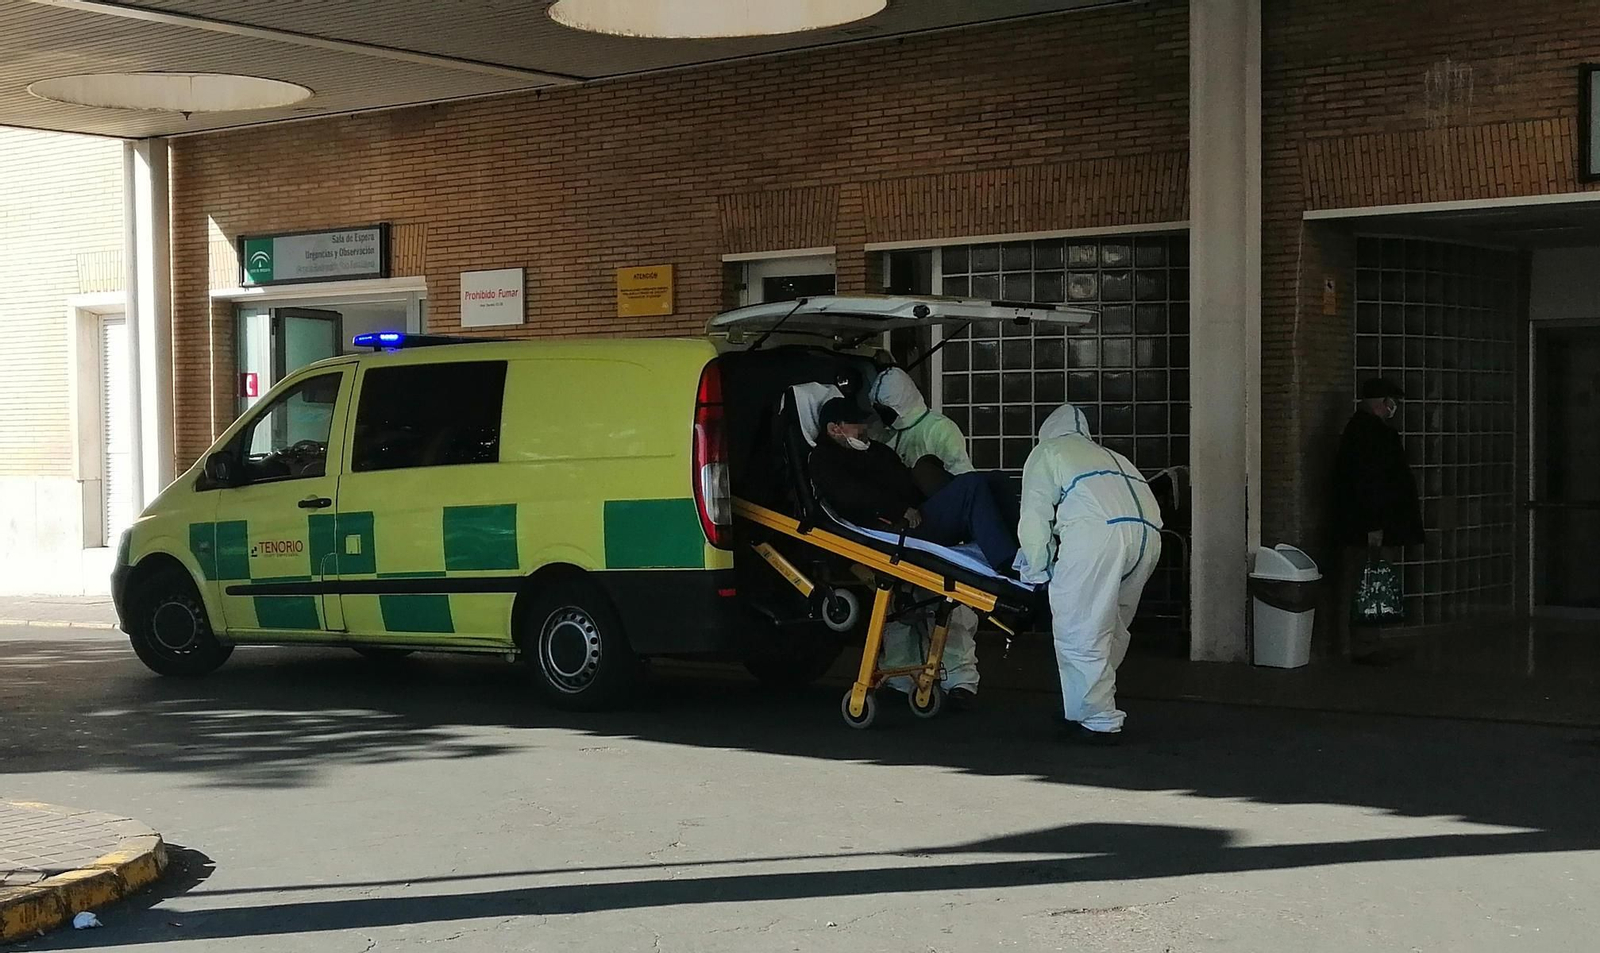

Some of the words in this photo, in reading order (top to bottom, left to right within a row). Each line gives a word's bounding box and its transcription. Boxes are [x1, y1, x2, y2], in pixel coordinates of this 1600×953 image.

[332, 234, 344, 243] Sala
[346, 234, 353, 243] de
[354, 233, 375, 244] Espera
[305, 248, 333, 261] Urgencias
[333, 251, 338, 259] y
[339, 246, 375, 257] Observación
[464, 289, 496, 301] Prohibido
[498, 288, 519, 298] Fumar
[259, 540, 304, 553] TENORIO
